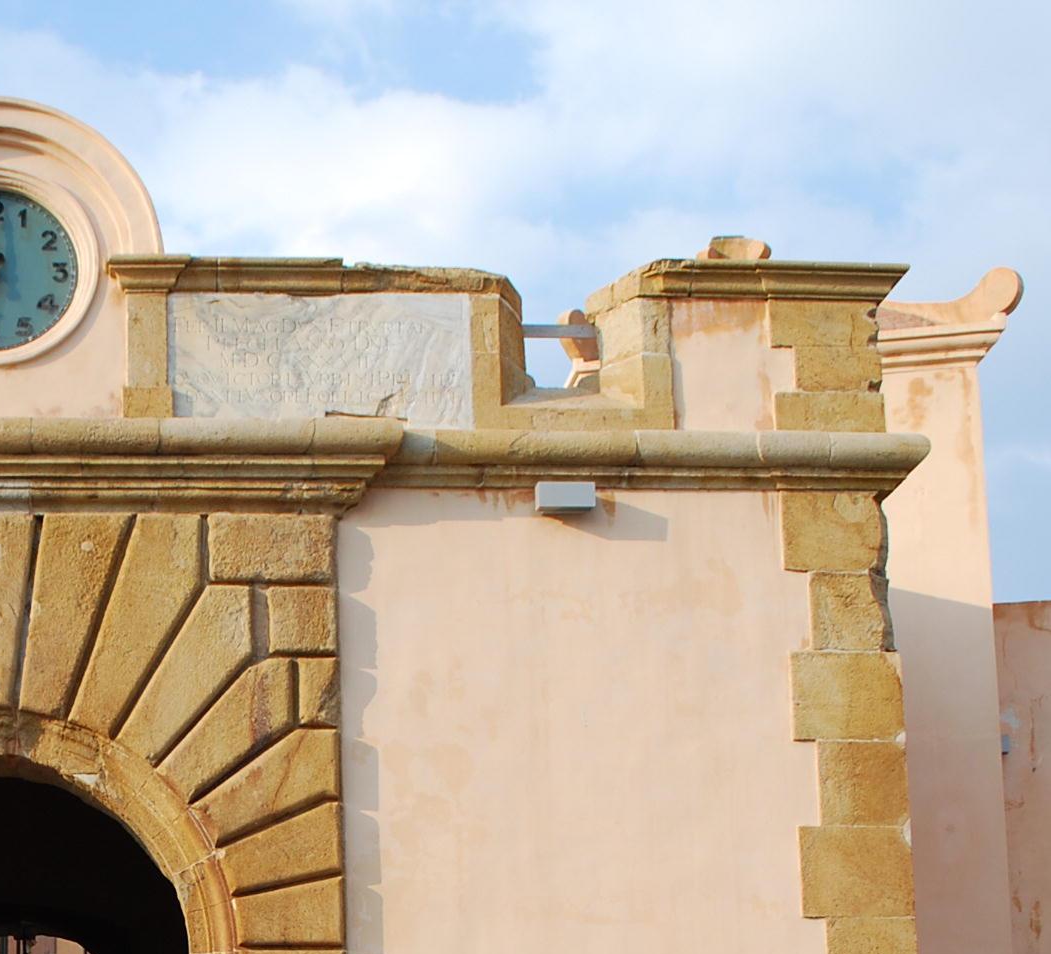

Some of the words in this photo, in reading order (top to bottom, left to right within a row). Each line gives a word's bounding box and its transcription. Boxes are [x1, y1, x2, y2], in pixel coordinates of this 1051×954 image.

[18, 208, 28, 228] 1
[41, 230, 58, 252] 2
[52, 262, 69, 284] 3
[36, 293, 59, 315] 4
[15, 316, 34, 338] 5
